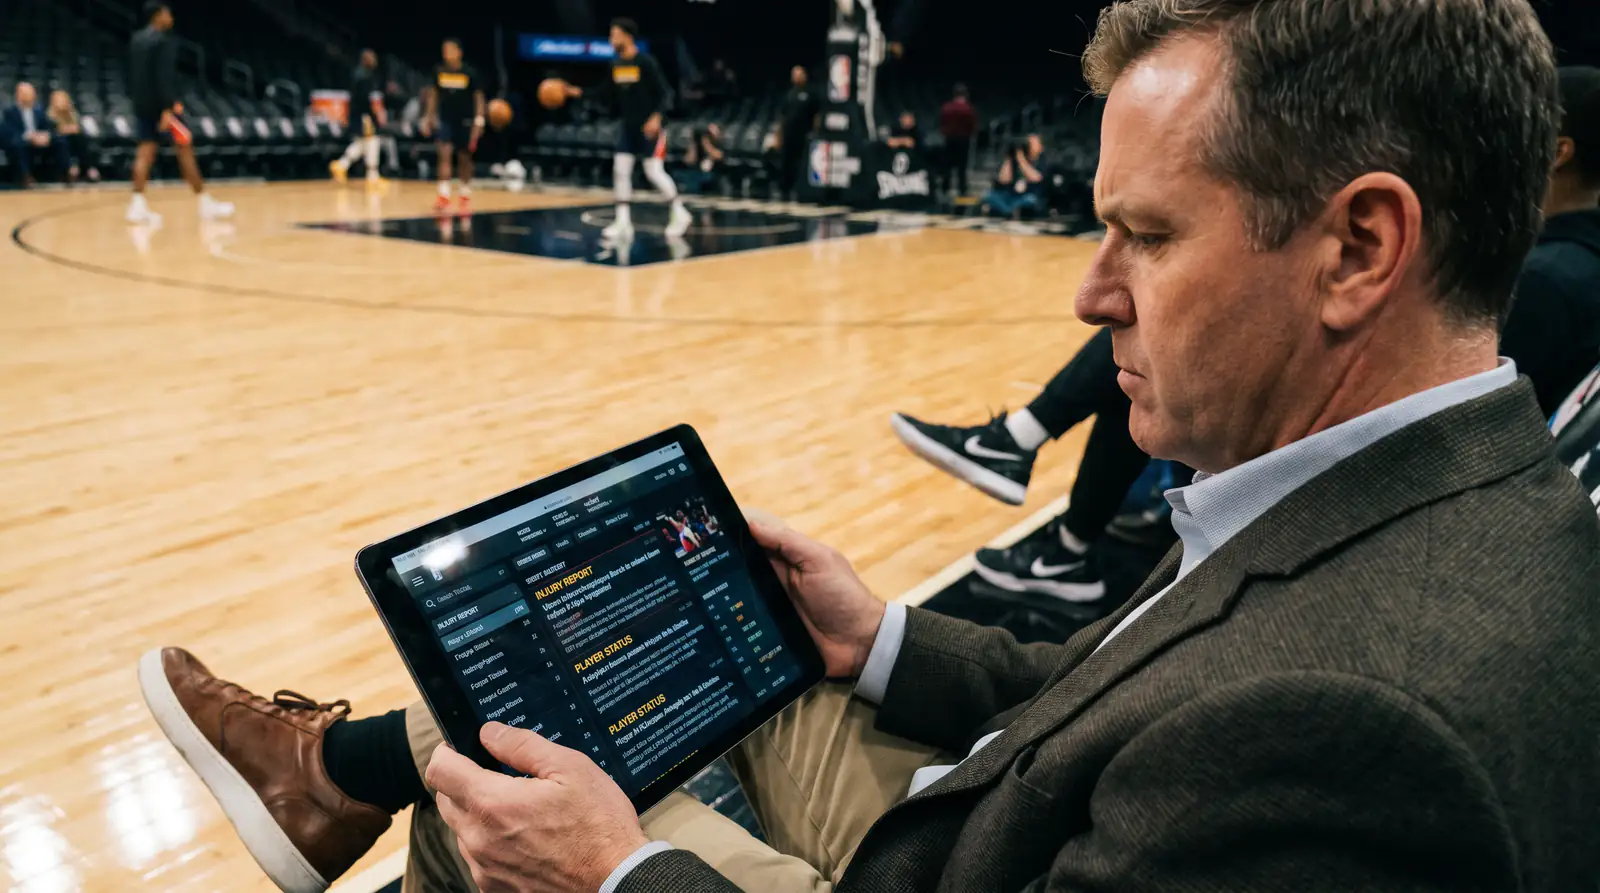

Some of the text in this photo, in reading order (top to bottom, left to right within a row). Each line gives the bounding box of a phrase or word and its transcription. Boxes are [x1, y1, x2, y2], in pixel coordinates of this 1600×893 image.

[535, 581, 563, 600] INJURY
[563, 566, 593, 586] REPORT
[457, 605, 479, 621] REPORT
[575, 635, 632, 673] PLAYER STATUS
[609, 694, 666, 735] PLAYER STATUS
